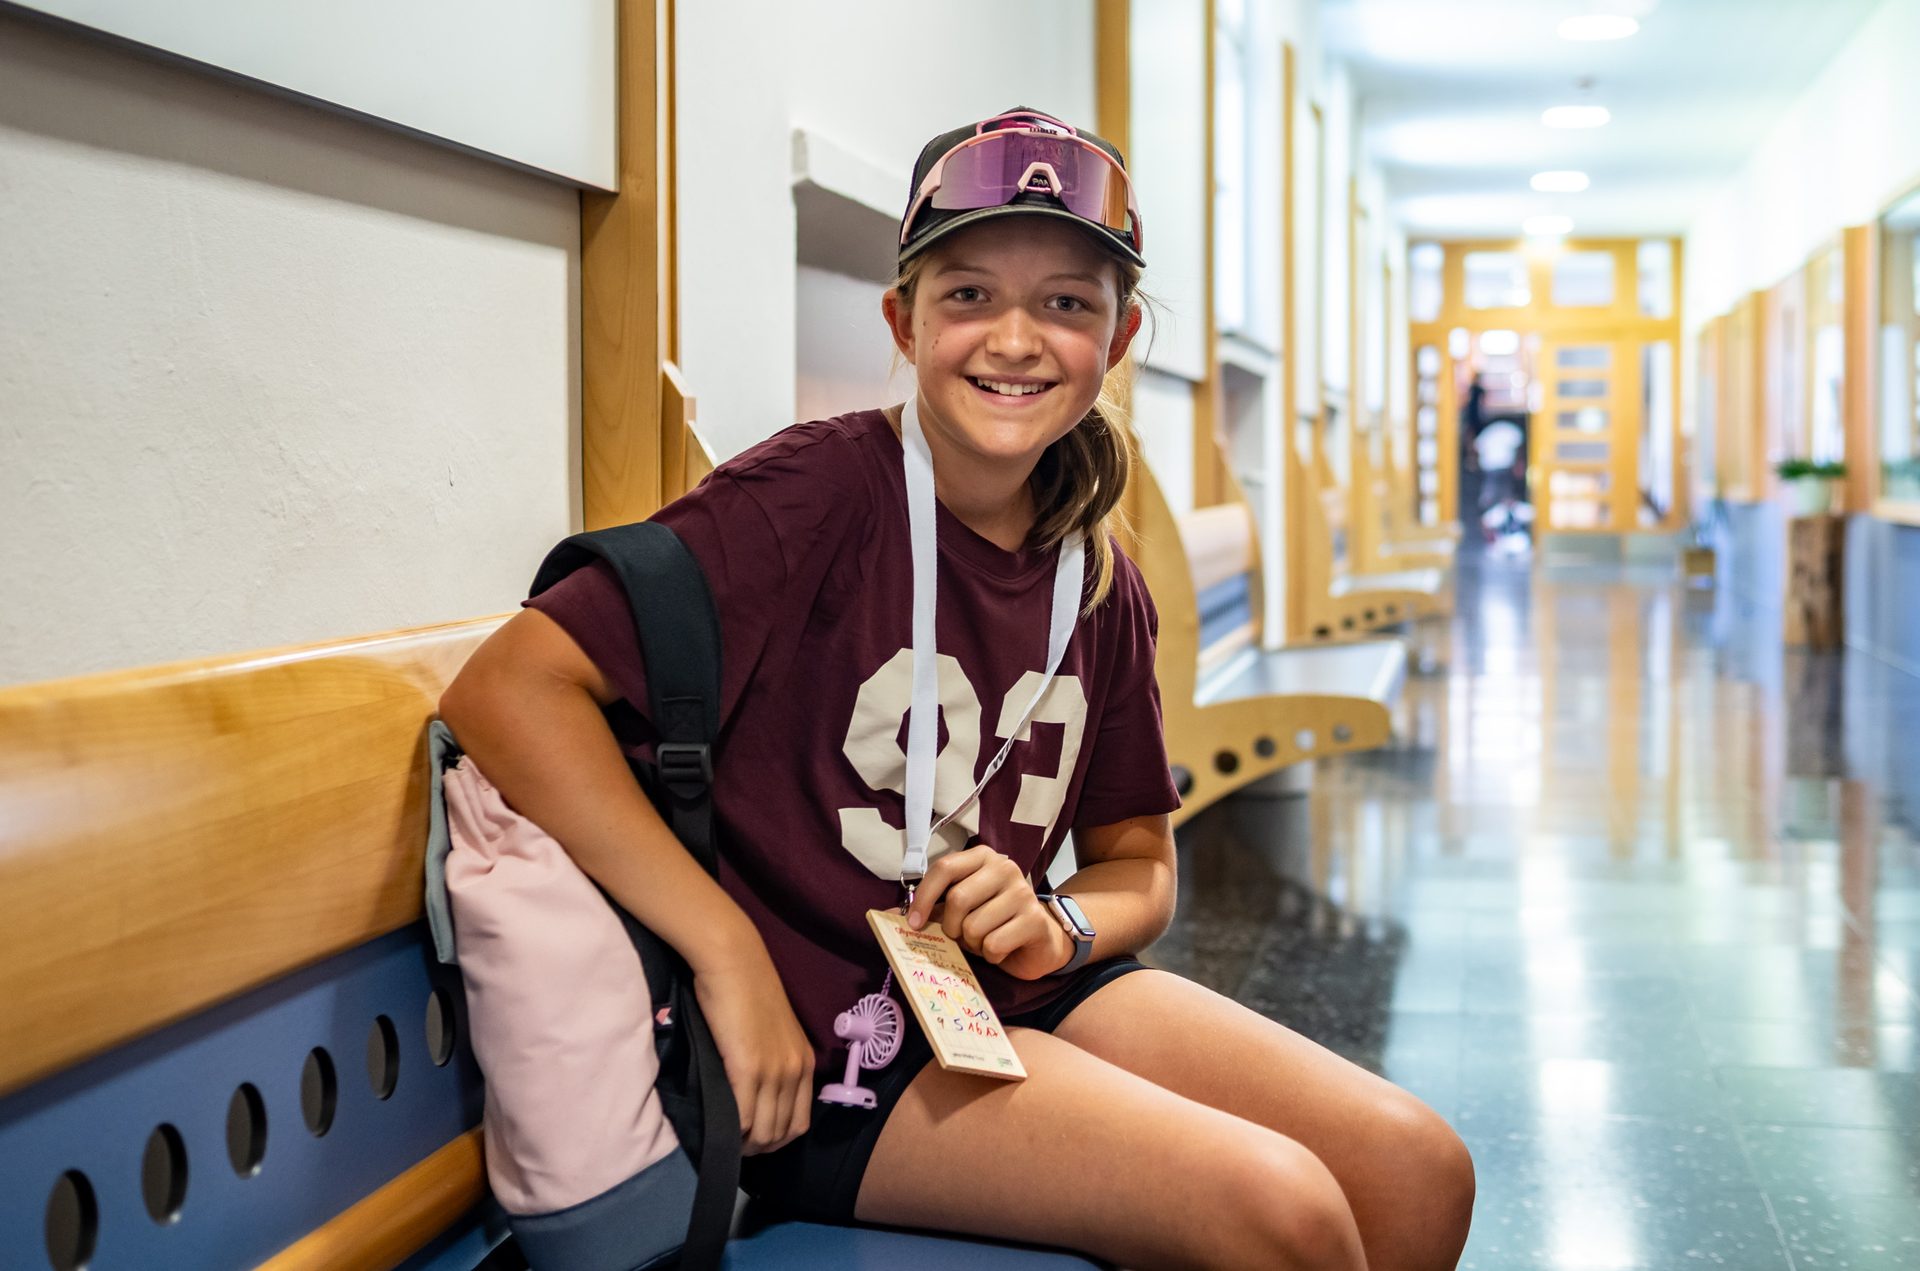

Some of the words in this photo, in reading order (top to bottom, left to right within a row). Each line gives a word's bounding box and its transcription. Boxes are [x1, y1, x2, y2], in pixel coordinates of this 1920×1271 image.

[837, 647, 1088, 881] 93
[929, 1000, 941, 1011] 2
[953, 1018, 964, 1031] 5
